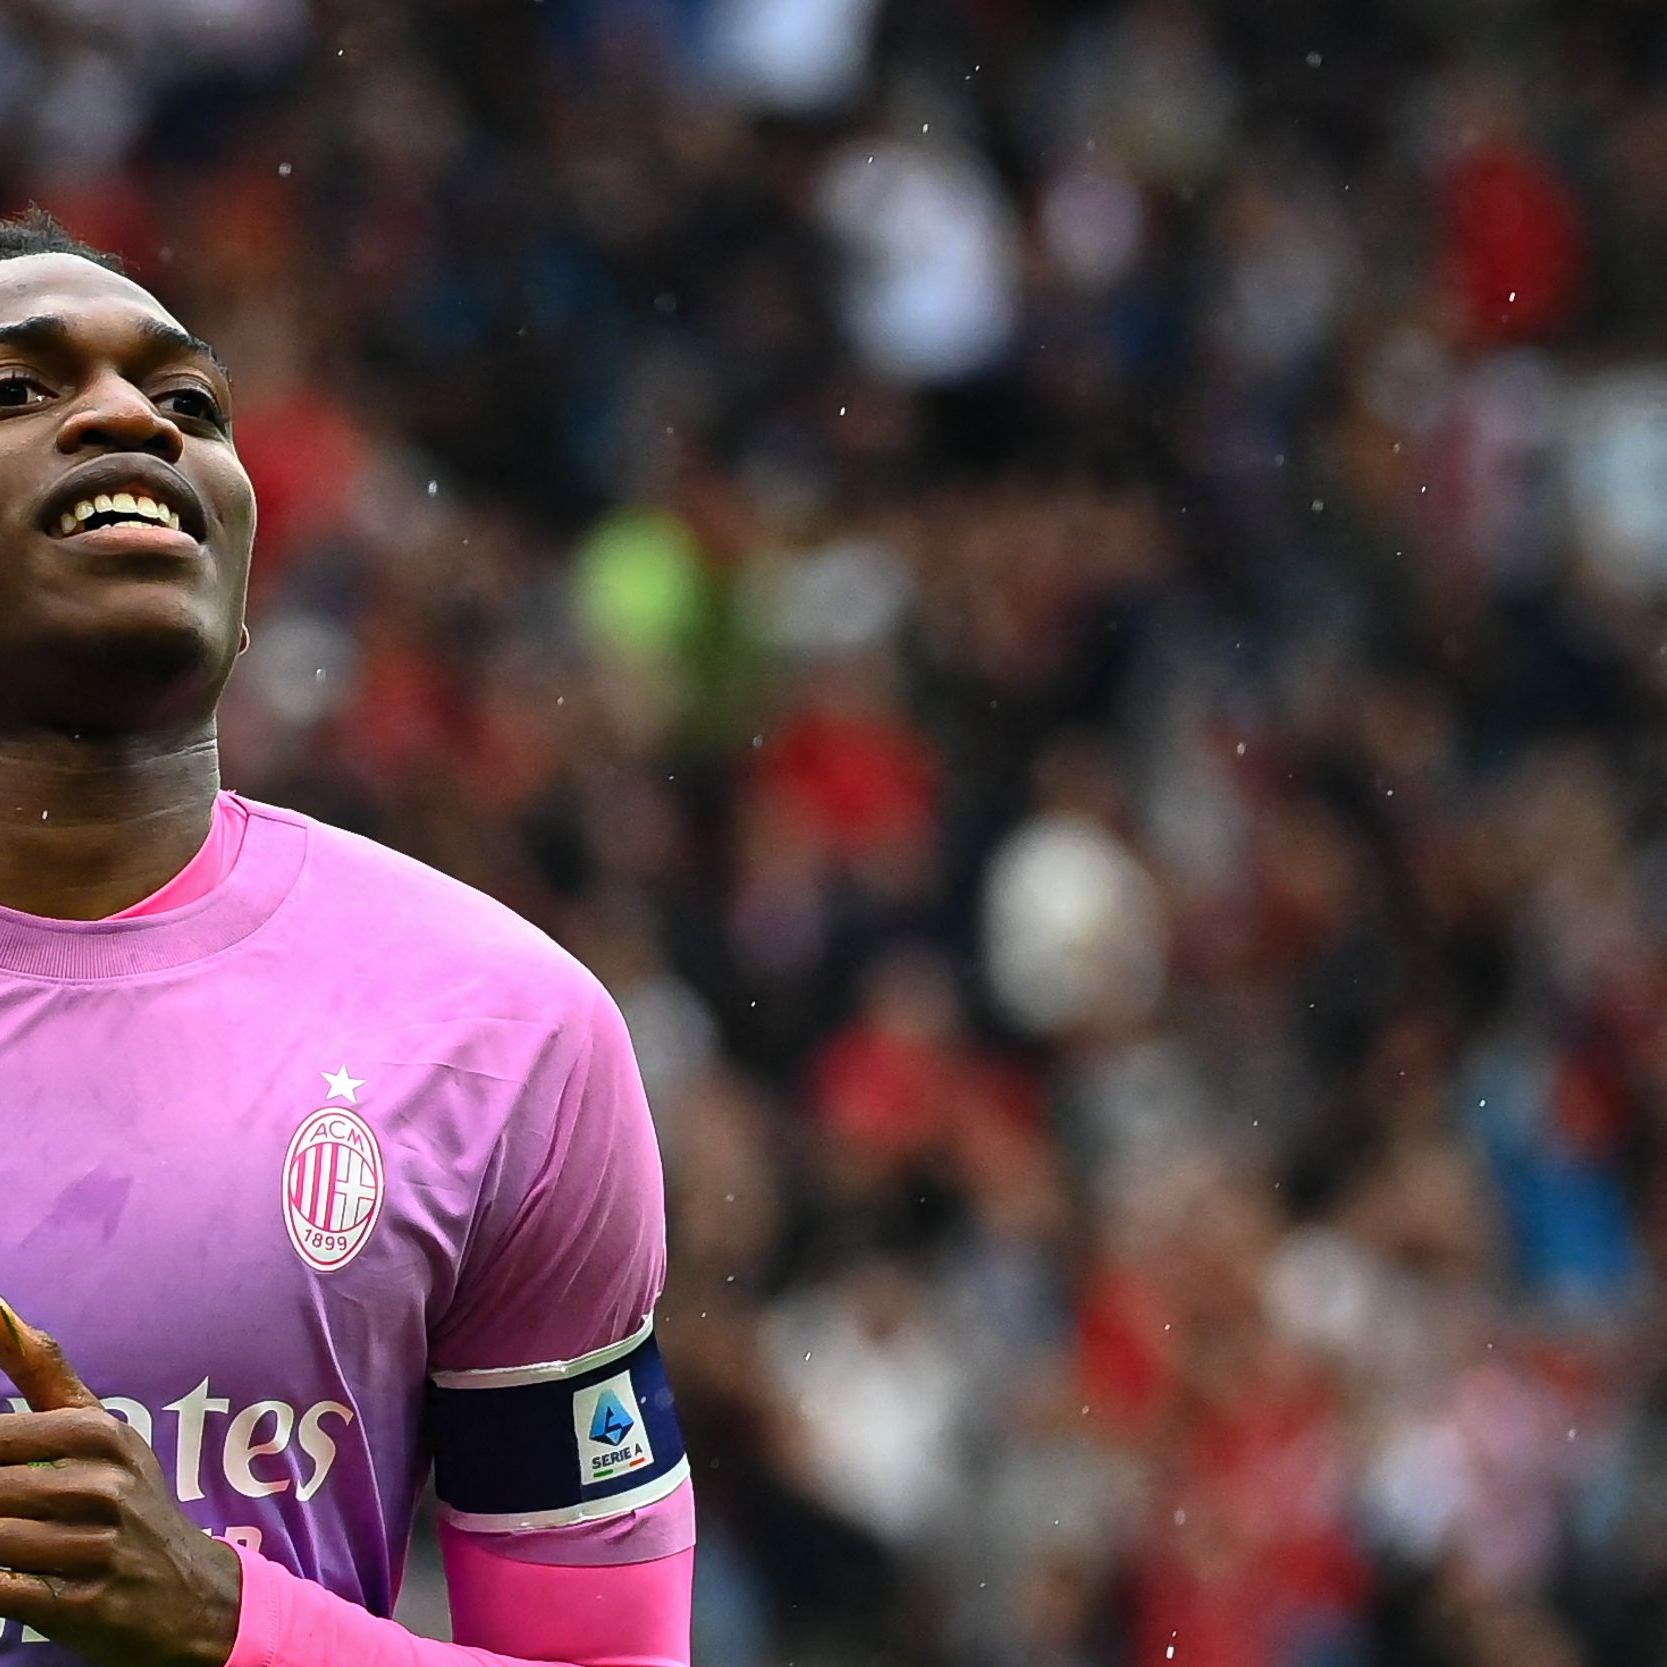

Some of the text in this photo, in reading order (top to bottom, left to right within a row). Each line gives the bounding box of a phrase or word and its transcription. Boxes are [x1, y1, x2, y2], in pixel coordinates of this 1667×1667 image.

[310, 1120, 365, 1152] ACM
[303, 1228, 349, 1251] 1899
[592, 1443, 643, 1469] SERIE A
